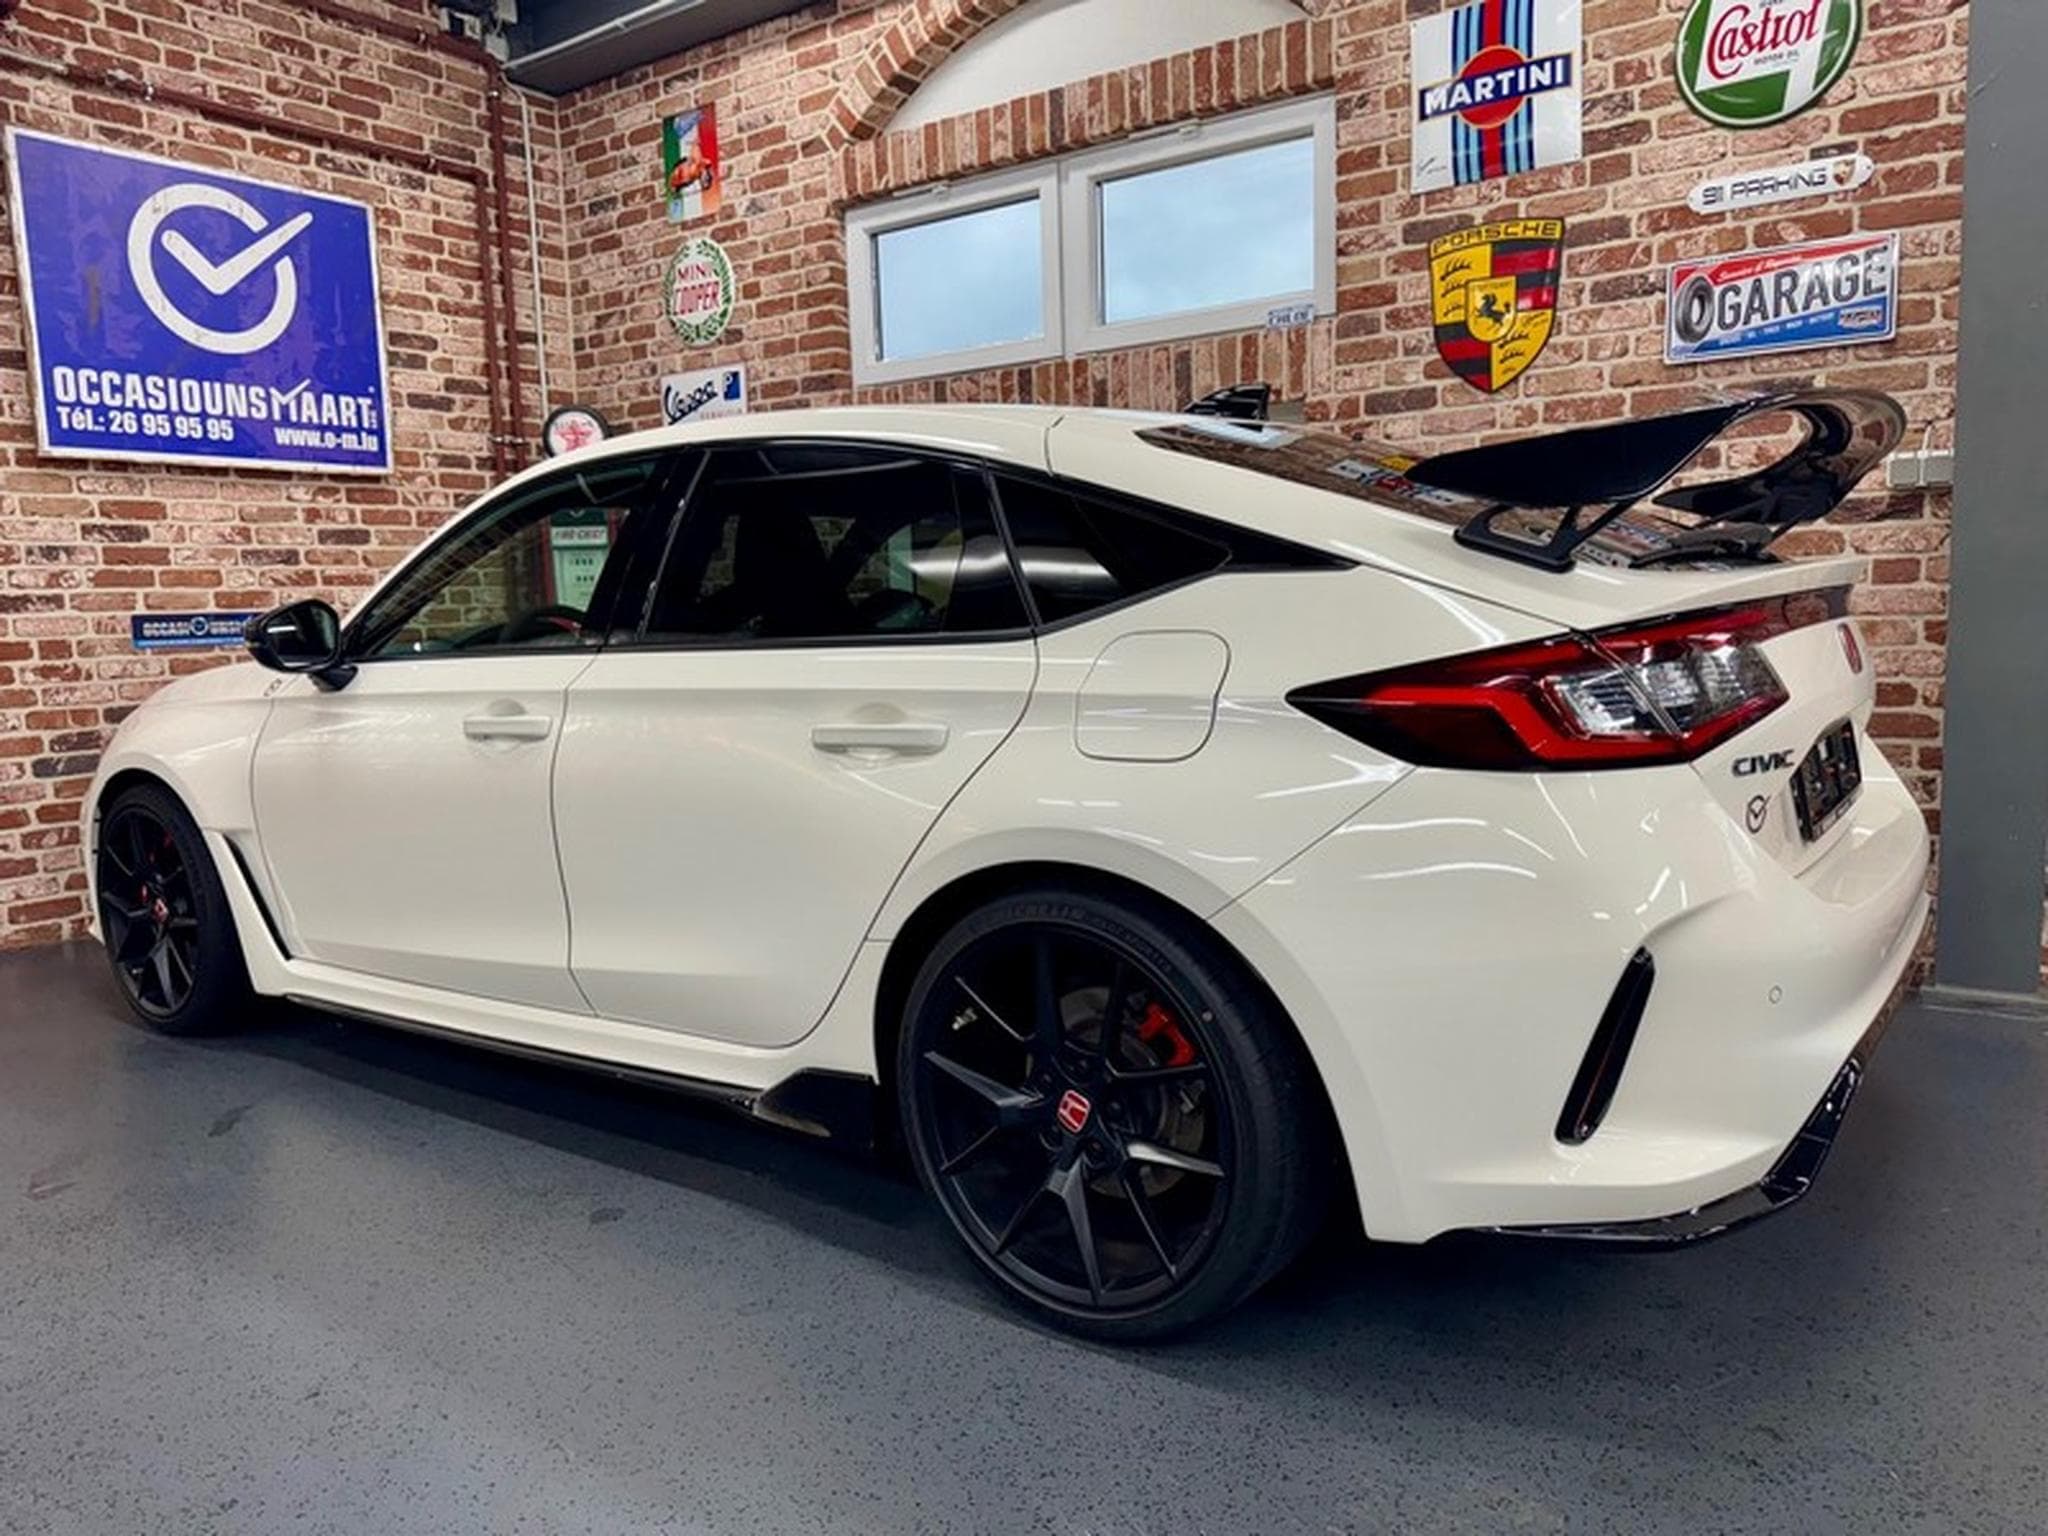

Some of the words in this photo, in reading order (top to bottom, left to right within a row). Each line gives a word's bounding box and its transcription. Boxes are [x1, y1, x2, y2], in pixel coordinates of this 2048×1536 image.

[1707, 0, 1823, 80] Castrol
[1424, 58, 1564, 116] MARTINI
[1730, 168, 1827, 200] PARKING
[1433, 222, 1558, 253] PORSCHE
[678, 263, 720, 280] MINI
[1716, 245, 1889, 331] GARAGE
[673, 281, 720, 316] COOPER
[664, 384, 718, 426] Vespa
[56, 406, 105, 432] Tél.:
[109, 410, 138, 434] 26
[142, 414, 171, 437] 95
[175, 416, 203, 439] 95
[207, 419, 234, 442] 95
[274, 427, 378, 451] www.o-m.lu
[1732, 749, 1795, 776] CIVIC
